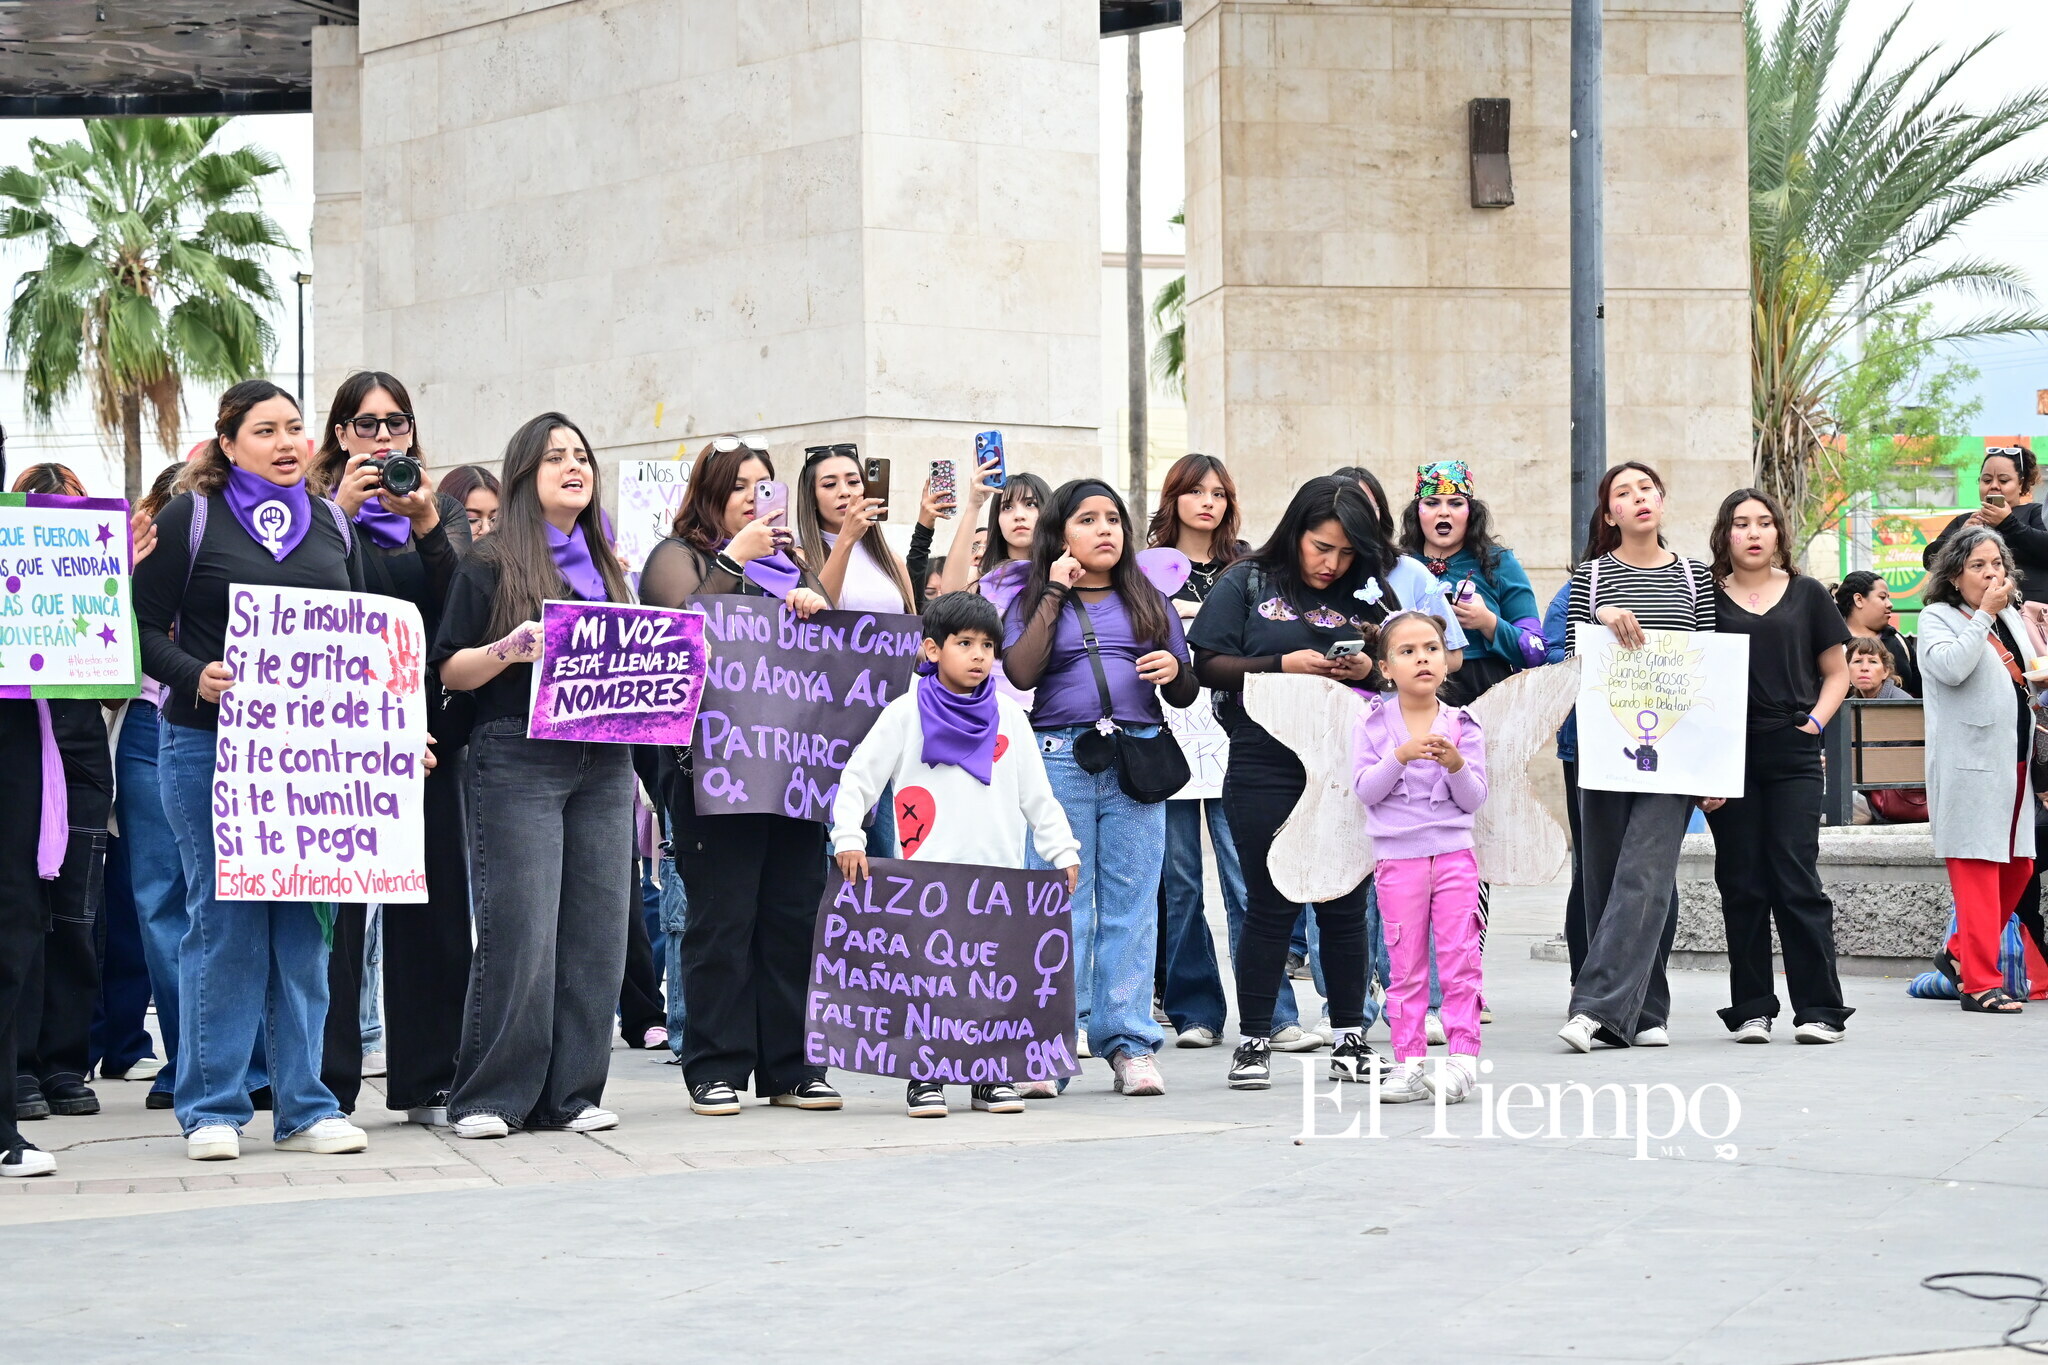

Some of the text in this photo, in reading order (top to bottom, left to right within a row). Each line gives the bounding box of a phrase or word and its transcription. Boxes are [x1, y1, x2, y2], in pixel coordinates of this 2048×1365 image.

[658, 484, 685, 506] VI
[0, 525, 90, 547] QUE FUERON
[665, 508, 676, 525] N
[16, 557, 44, 578] QUE
[51, 550, 121, 577] VENDRÁN
[32, 593, 64, 616] QUE
[72, 594, 120, 618] NUNCA
[230, 591, 388, 639] Si te insulta
[617, 616, 686, 649] VOZ
[692, 601, 921, 657] NIÑO BIEN CRIAD
[1654, 632, 1674, 654] te
[226, 644, 369, 689] Si te grita
[553, 651, 690, 678] ESTÁ LLENA DE
[1609, 663, 1647, 680] Cuando
[1617, 651, 1684, 672] pone Grande
[554, 678, 690, 717] NOMBRES
[707, 656, 747, 691] NO
[844, 669, 893, 707] AL
[1608, 678, 1627, 692] pero
[1632, 678, 1652, 691] bien
[1609, 692, 1641, 709] Cuando
[1644, 696, 1654, 708] te
[219, 691, 405, 730] Si se rie de ti
[216, 737, 415, 779] Si te controla
[697, 710, 862, 769] PATRIARC
[214, 780, 400, 819] Si te humilla
[784, 766, 839, 823] 8M
[215, 821, 378, 863] Si te pega
[218, 859, 426, 898] Estas Sufriendo Violencia
[834, 876, 948, 917] ALZO
[967, 878, 1012, 916] LA
[824, 913, 999, 967] PARA QUE
[815, 952, 1017, 1002] MAÑANA NO
[809, 990, 1035, 1045] FALTE NINGUNA
[806, 1031, 845, 1069] EN
[855, 1037, 897, 1074] MI
[1026, 1033, 1076, 1081] 8M
